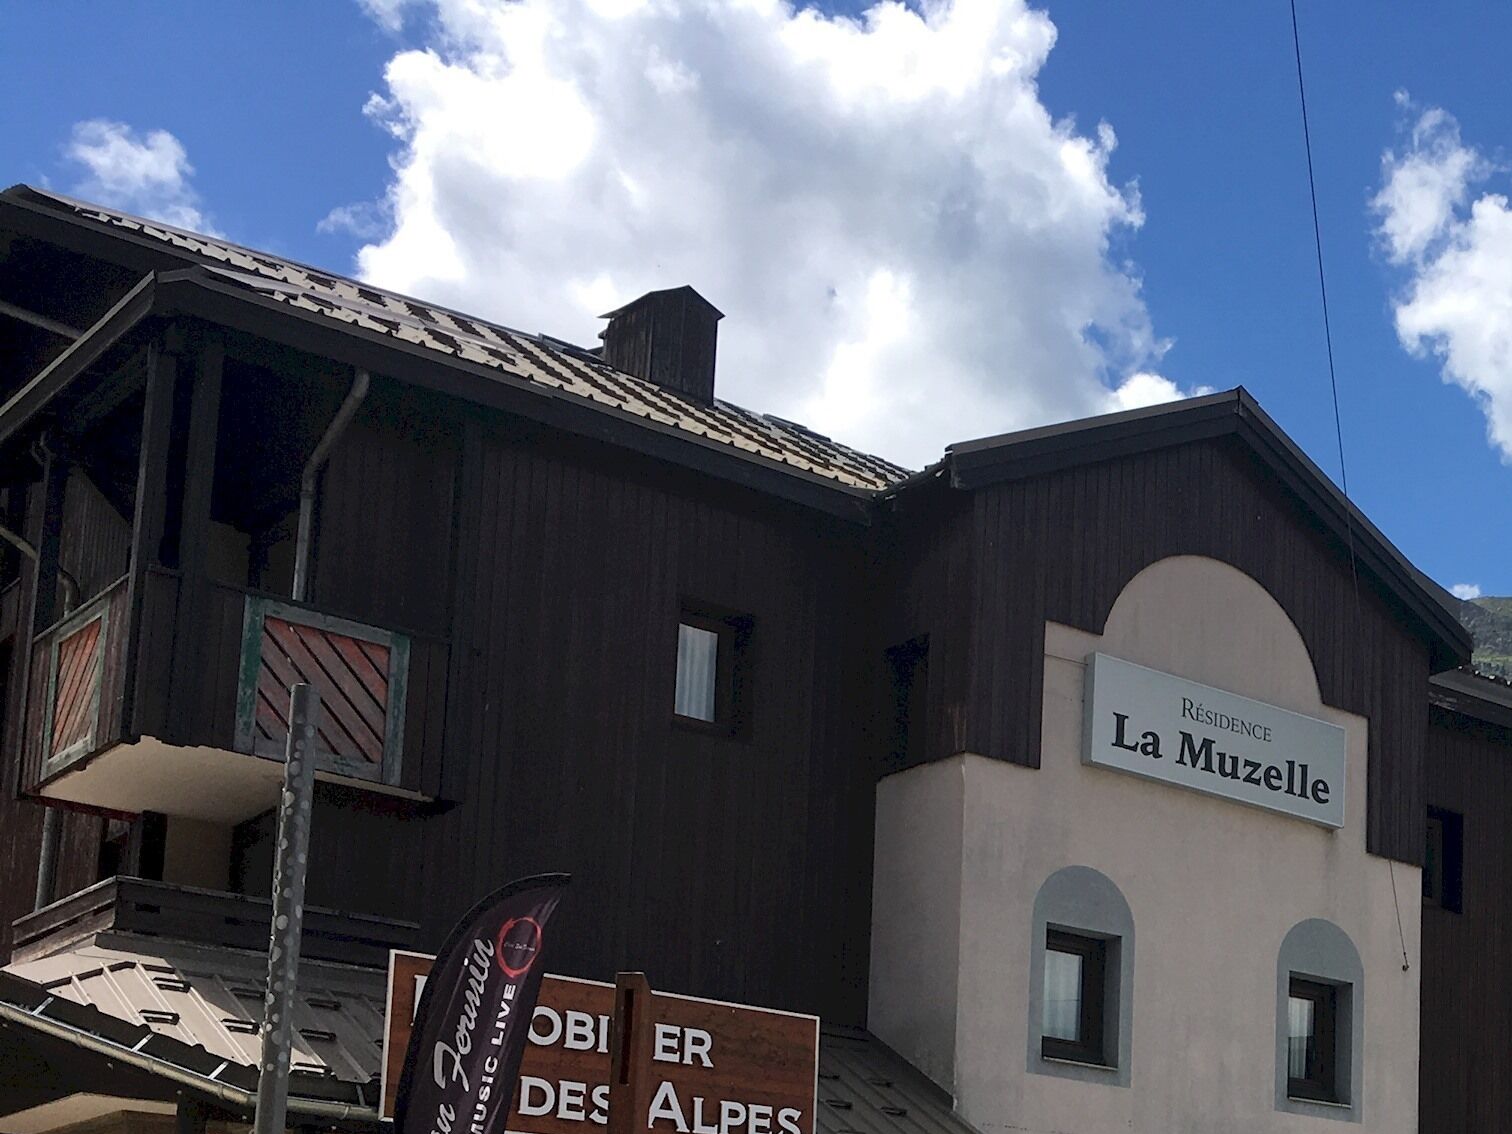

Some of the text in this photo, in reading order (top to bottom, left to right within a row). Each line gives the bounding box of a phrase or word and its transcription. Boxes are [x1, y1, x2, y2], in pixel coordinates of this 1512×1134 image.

[1181, 696, 1273, 743] RÉSIDENCE
[1111, 711, 1331, 805] La Muzelle
[490, 983, 517, 1046] LIVE
[518, 1076, 610, 1124] DES
